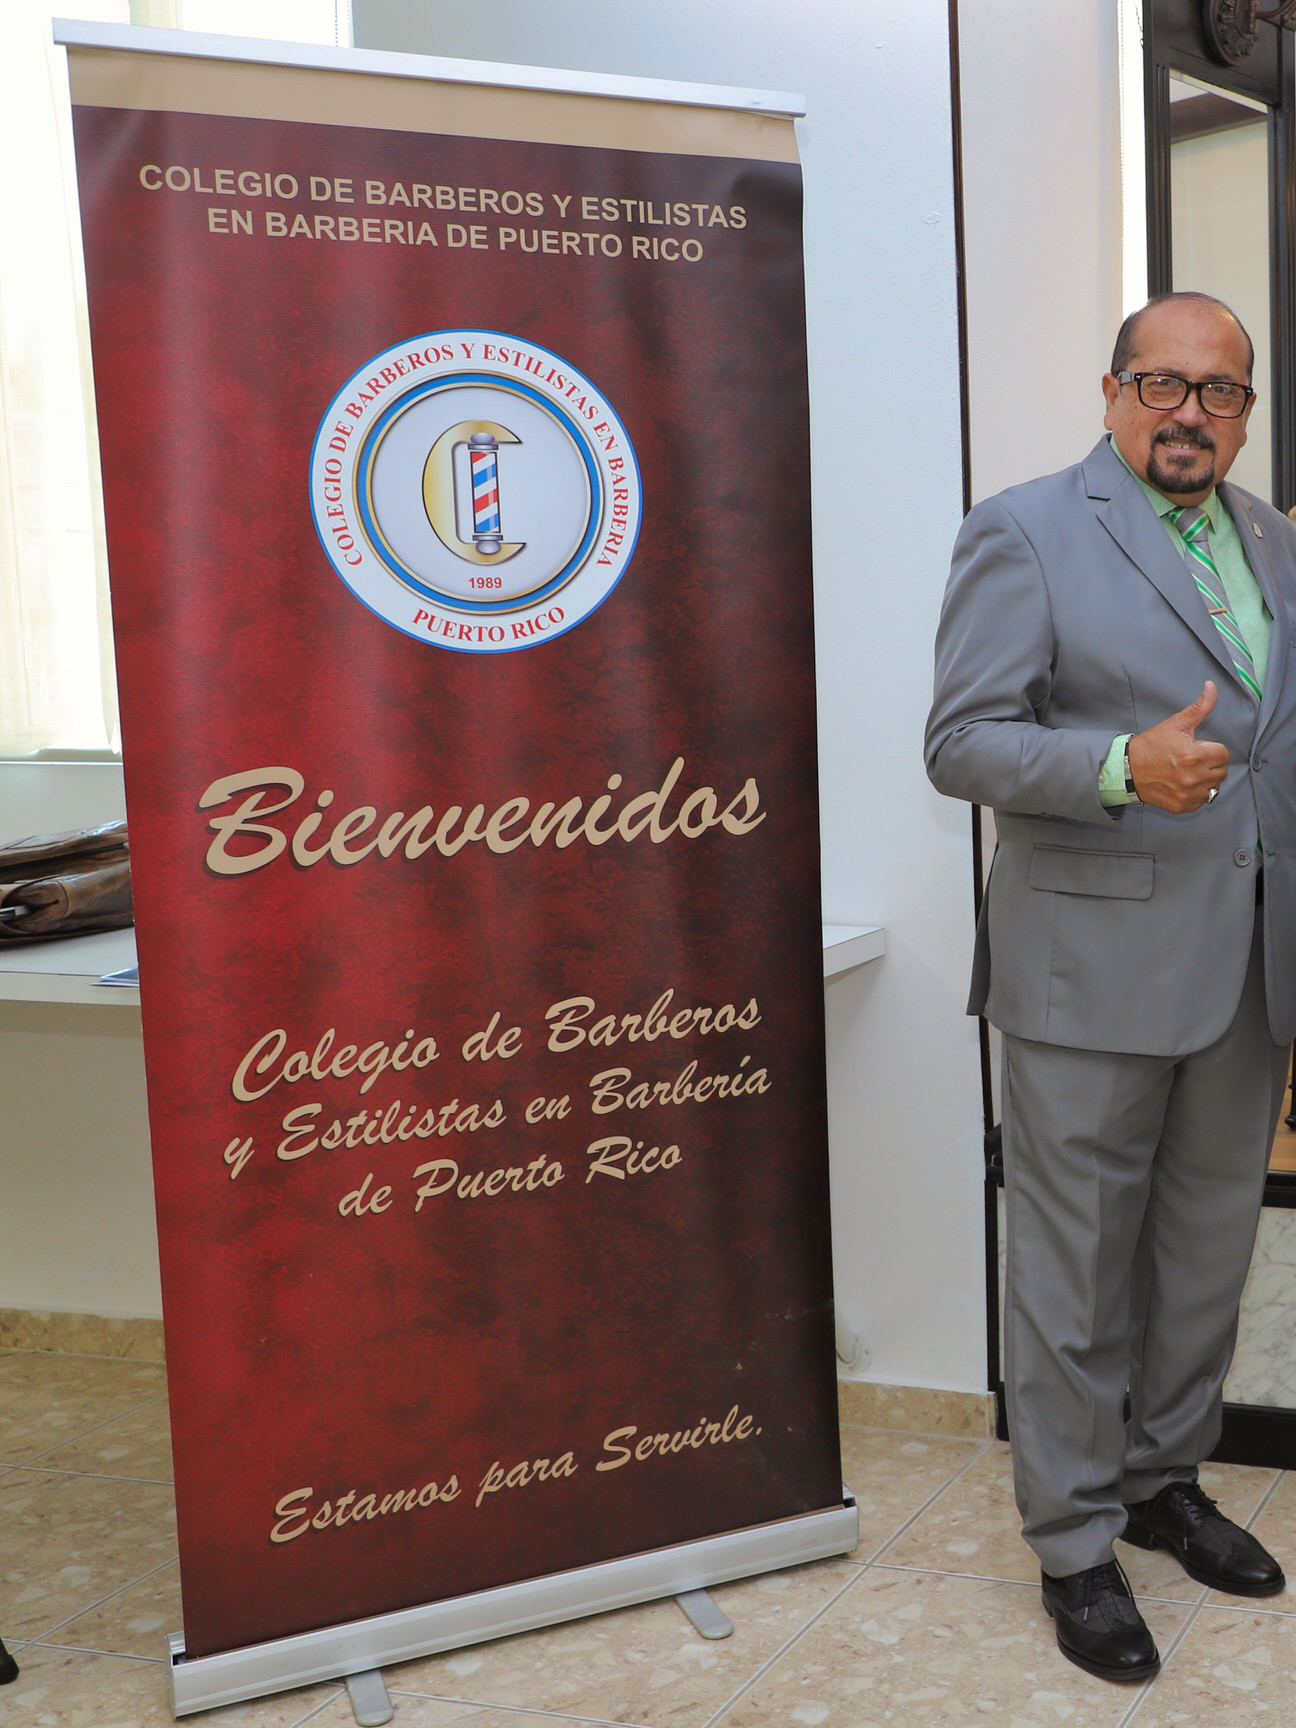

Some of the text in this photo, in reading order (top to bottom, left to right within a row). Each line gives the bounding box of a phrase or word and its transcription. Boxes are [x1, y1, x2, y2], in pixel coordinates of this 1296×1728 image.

[139, 164, 748, 230] COLEGIO DE BARBEROS Y ESTILISTAS
[207, 207, 704, 263] EN BARBERIA DE PUERTO RICO
[324, 343, 629, 567] COLEGIO DE BARBEROS Y ESTILISTAS EN BARBERIA
[412, 606, 565, 642] PUERTO RICO
[468, 577, 502, 589] 1989
[198, 757, 768, 876] Bienvenidos
[231, 988, 762, 1103] Colegio de Barberos
[223, 1056, 773, 1180] y Estilistas en Barbería
[338, 1135, 684, 1217] de Puerto Rico
[270, 1404, 763, 1543] Estamos para Servirle.
